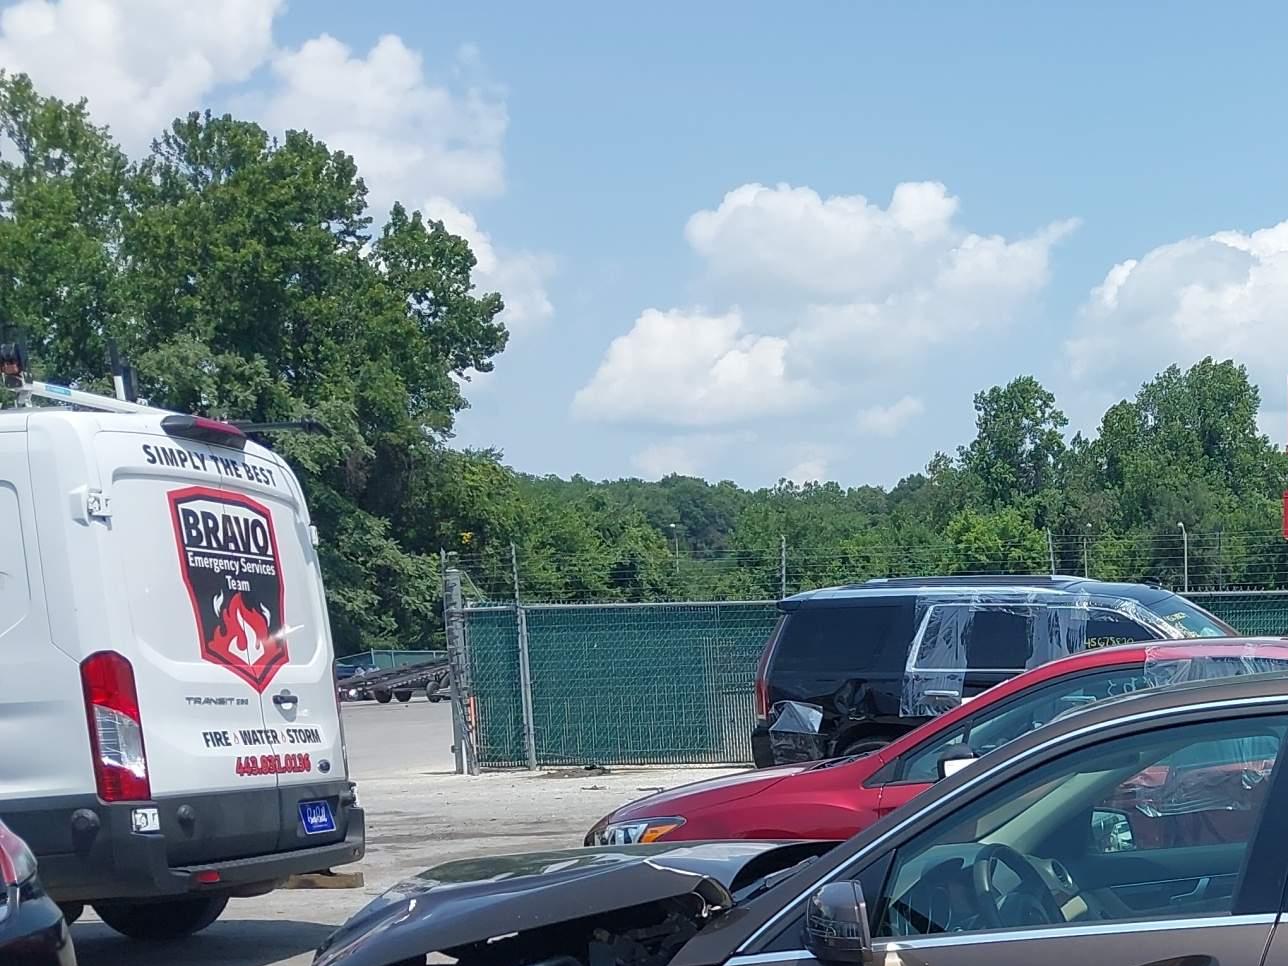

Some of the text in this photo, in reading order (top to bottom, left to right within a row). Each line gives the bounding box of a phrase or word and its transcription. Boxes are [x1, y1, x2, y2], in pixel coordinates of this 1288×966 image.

[142, 444, 276, 487] SIMPLY THE BEST
[181, 508, 269, 554] BRAVO
[188, 552, 276, 576] Emergency Services
[225, 575, 250, 592] Team
[185, 697, 235, 705] TRANSIT
[202, 729, 322, 748] FIRE WATER STORM
